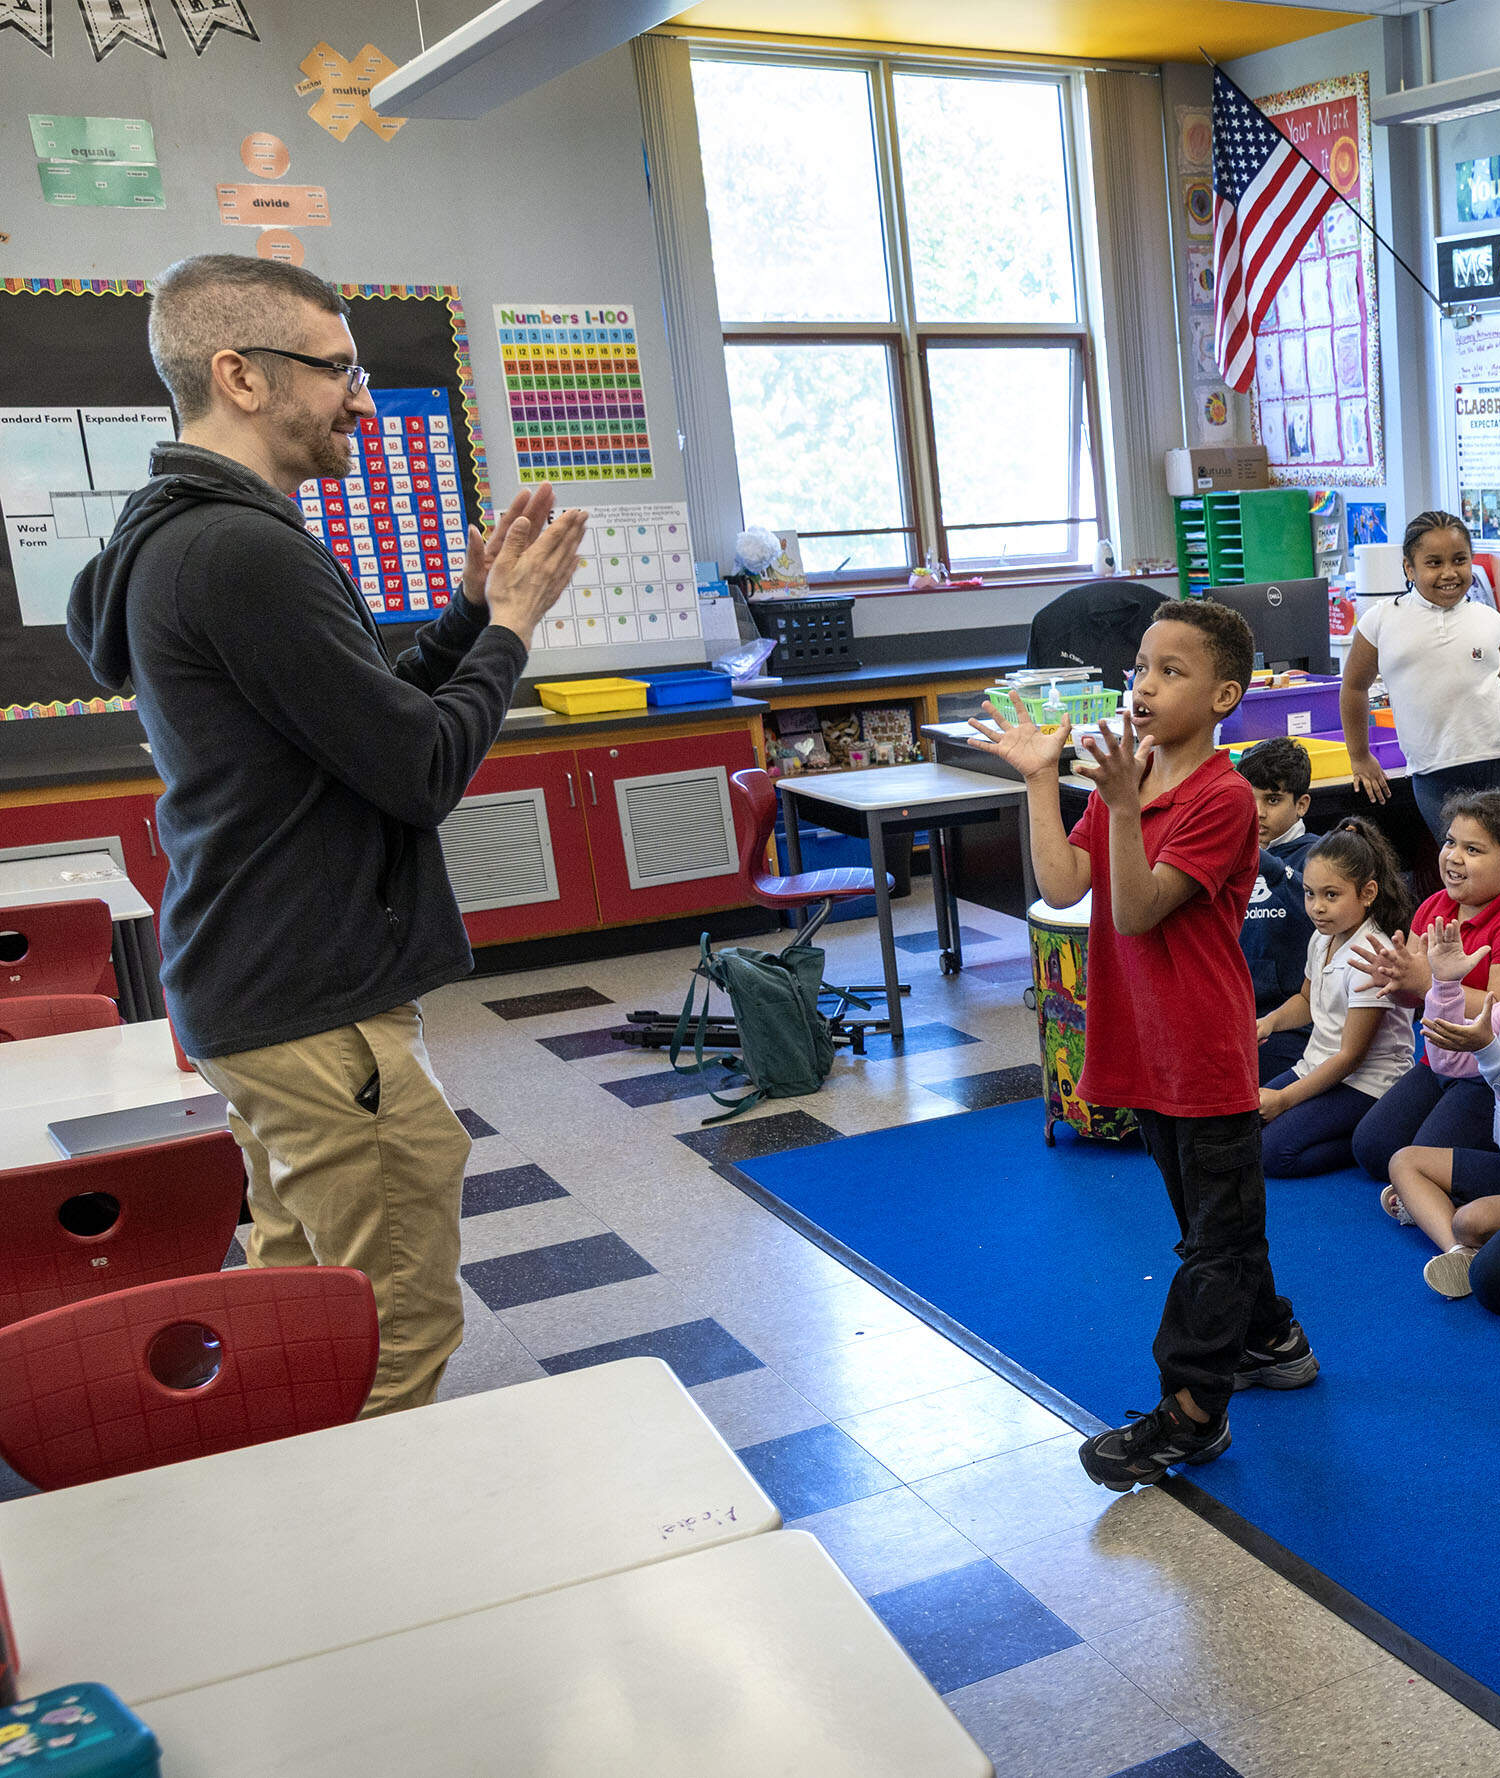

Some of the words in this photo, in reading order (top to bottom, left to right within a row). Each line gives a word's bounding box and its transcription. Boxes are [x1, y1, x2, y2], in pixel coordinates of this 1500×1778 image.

[1285, 117, 1312, 143] Your
[1317, 104, 1349, 136] Mark
[71, 147, 116, 159] equals
[252, 199, 291, 209] divide
[501, 310, 579, 324] Numbers
[585, 310, 628, 324] 1-100
[0, 414, 43, 424] andard
[44, 414, 73, 423] Form
[85, 414, 139, 424] Expanded
[140, 414, 167, 423] Form
[373, 482, 386, 490] 37
[396, 481, 408, 489] 38
[417, 480, 429, 489] 39
[441, 479, 454, 488] 40
[17, 524, 47, 533] Word
[19, 539, 48, 548] Form
